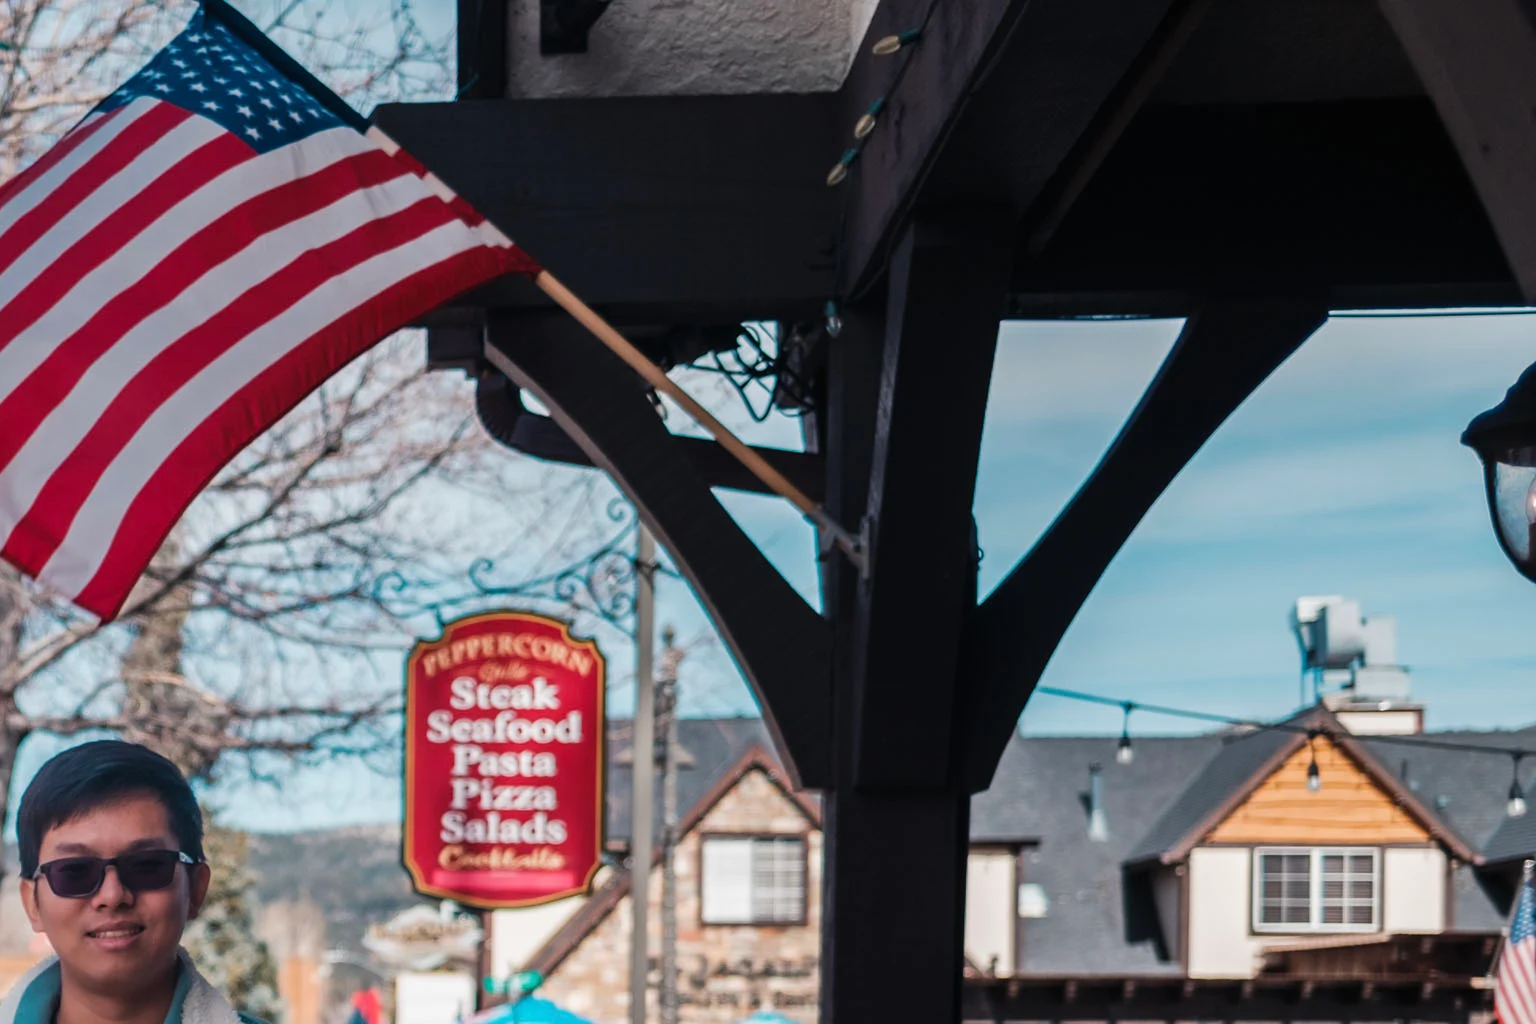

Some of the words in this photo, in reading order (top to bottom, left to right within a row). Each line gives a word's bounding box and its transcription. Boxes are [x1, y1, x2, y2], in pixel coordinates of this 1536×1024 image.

[423, 634, 593, 678] PEPPERCORN
[450, 676, 559, 710] Steak
[426, 709, 583, 743] Seafood
[452, 744, 557, 777] Pasta
[451, 777, 557, 810] Pizza
[440, 810, 567, 844] Salads
